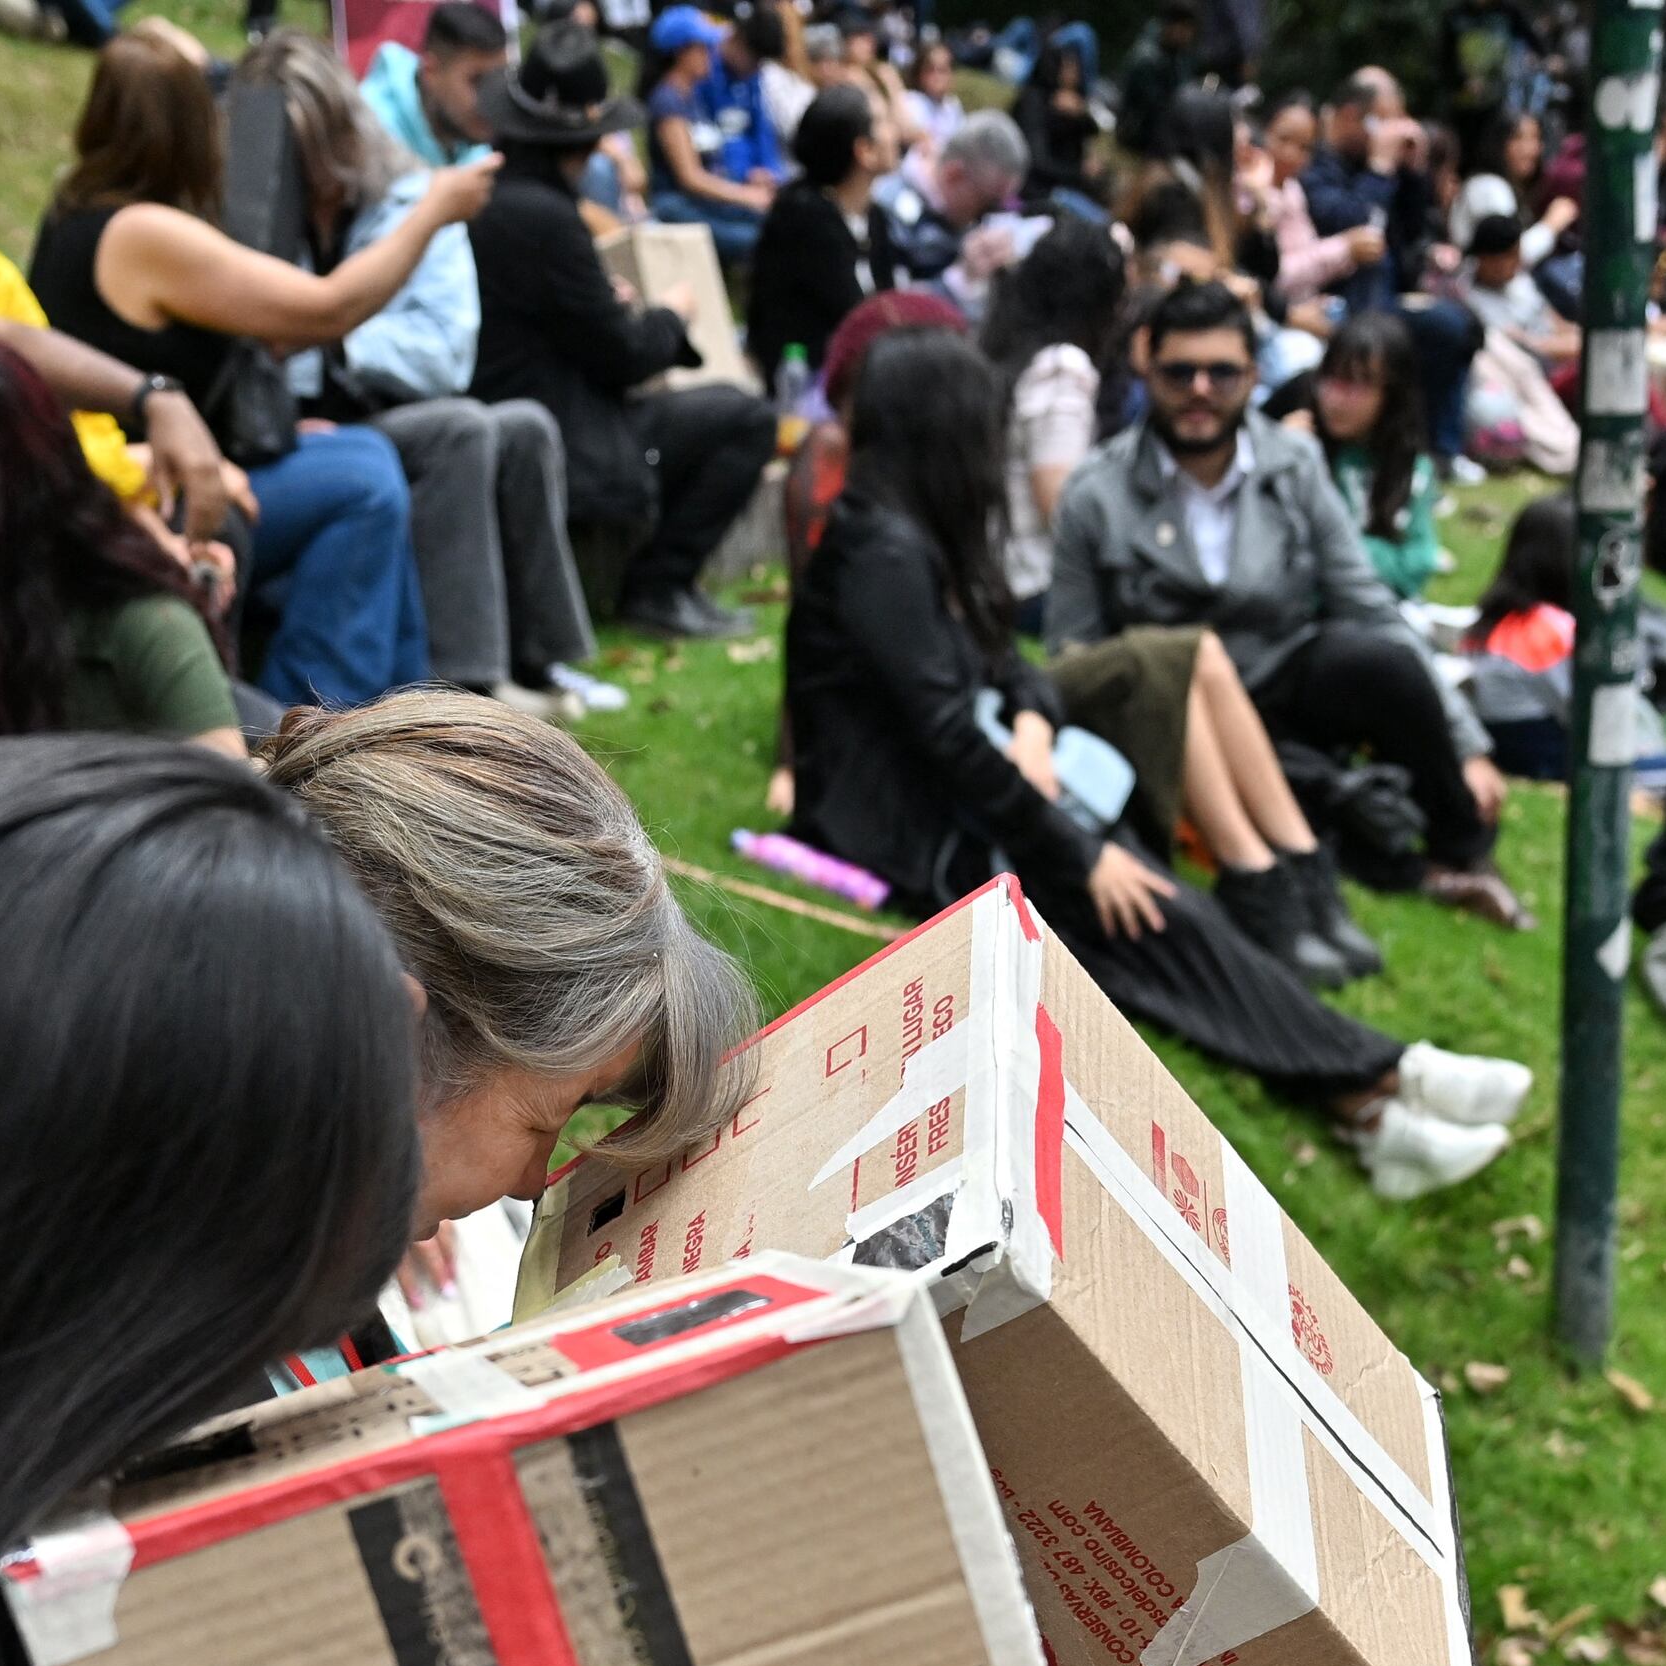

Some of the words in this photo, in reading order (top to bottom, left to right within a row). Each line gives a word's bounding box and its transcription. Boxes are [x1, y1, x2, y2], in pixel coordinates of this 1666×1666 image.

[902, 976, 925, 1050] LUGAR
[927, 1096, 951, 1157] FRES
[634, 1219, 660, 1284] AMBAR
[682, 1209, 707, 1275] NEGRA
[1019, 1511, 1060, 1548] 3222
[1085, 1502, 1176, 1598] COLOMBIANA
[1054, 1552, 1086, 1575] 487
[1085, 1579, 1118, 1610] PBX:
